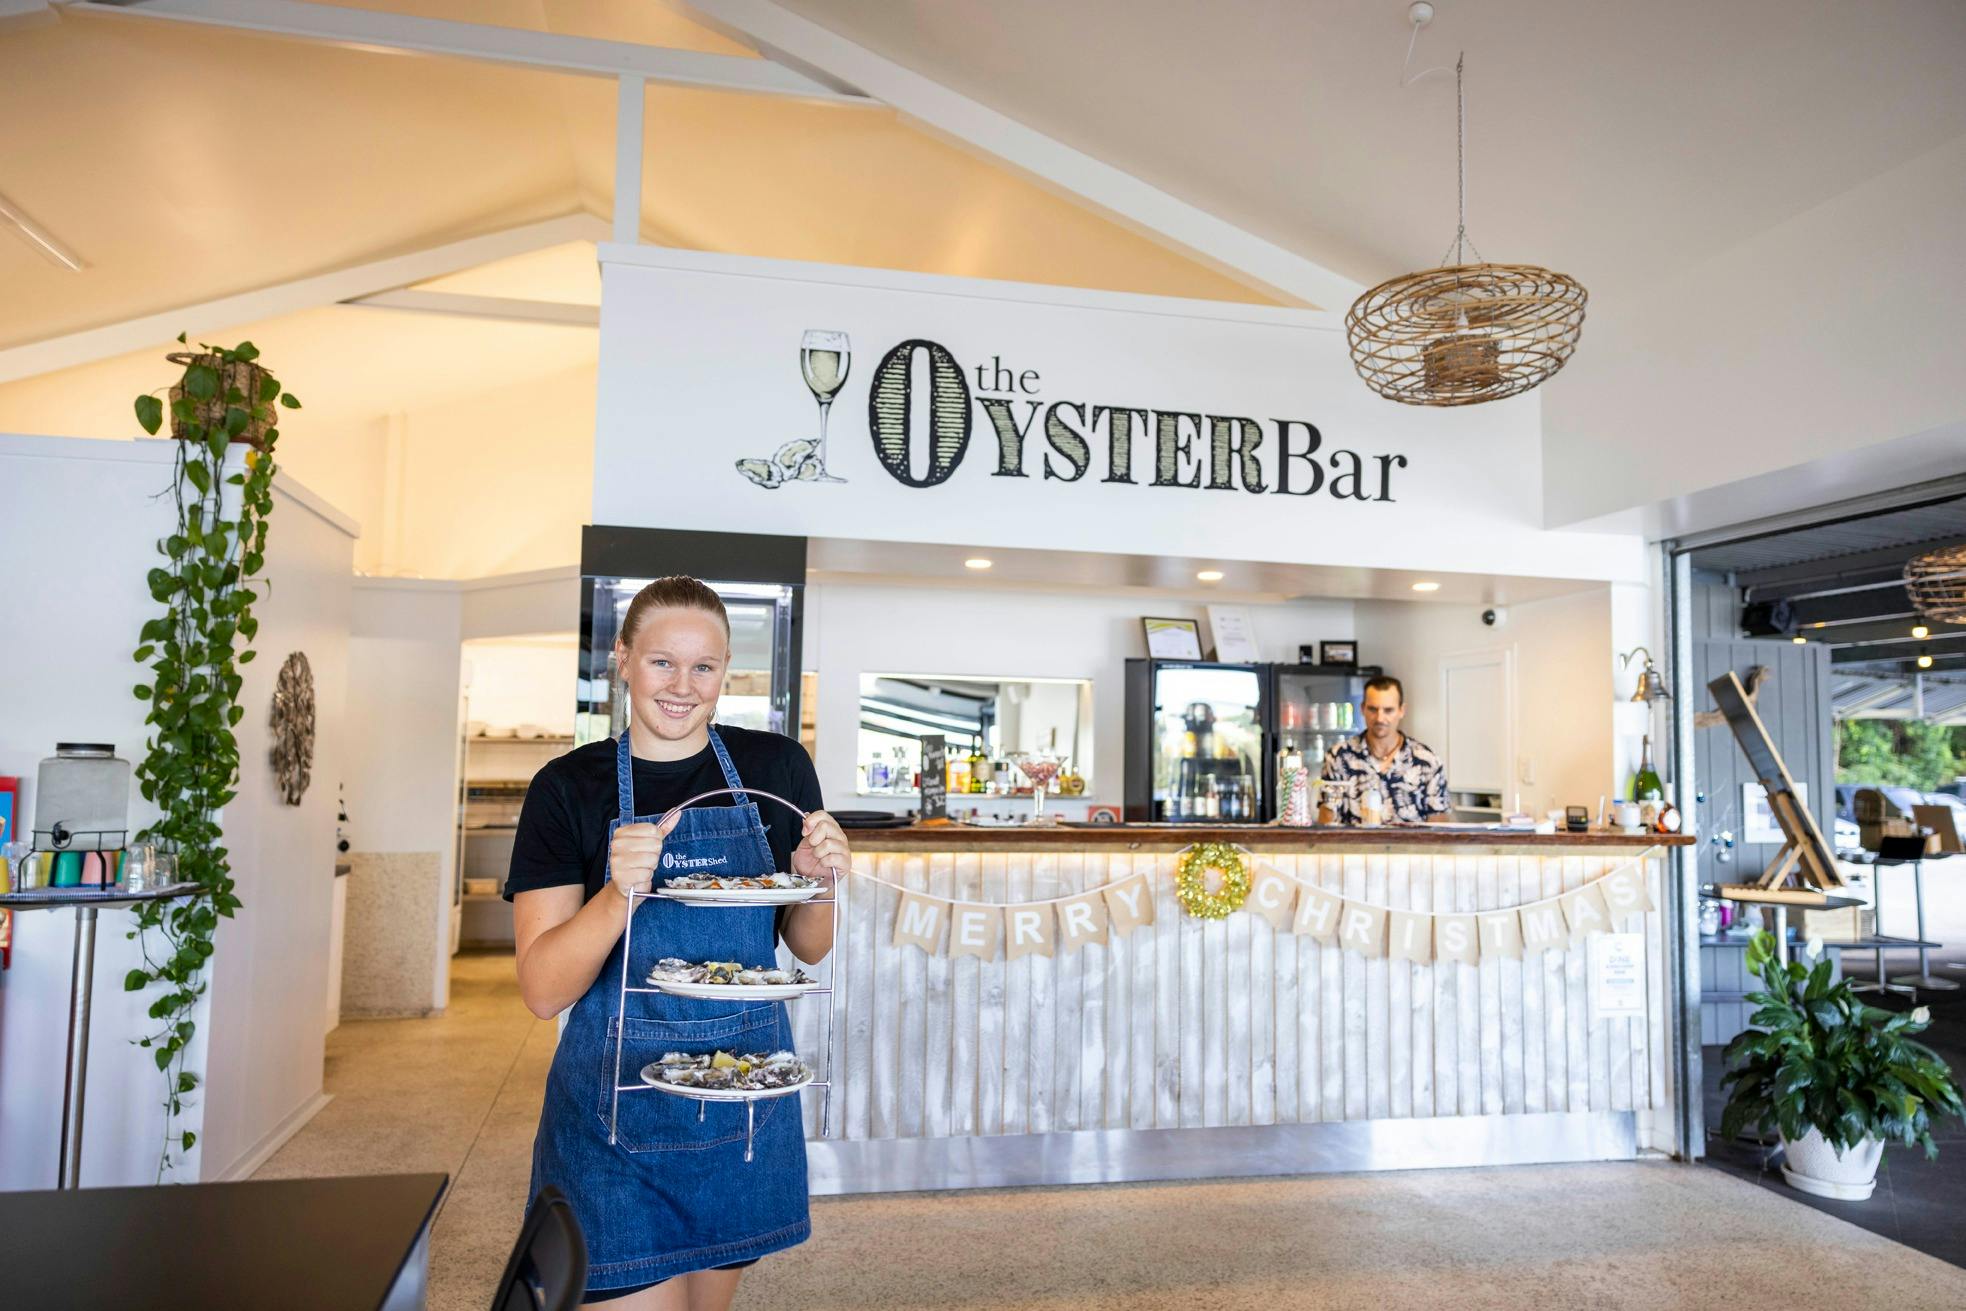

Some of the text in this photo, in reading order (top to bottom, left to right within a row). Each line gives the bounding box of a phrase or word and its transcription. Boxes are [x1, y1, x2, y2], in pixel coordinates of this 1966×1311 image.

[975, 356, 1041, 395] the
[902, 874, 1638, 951] MERRY CHRISTMAS
